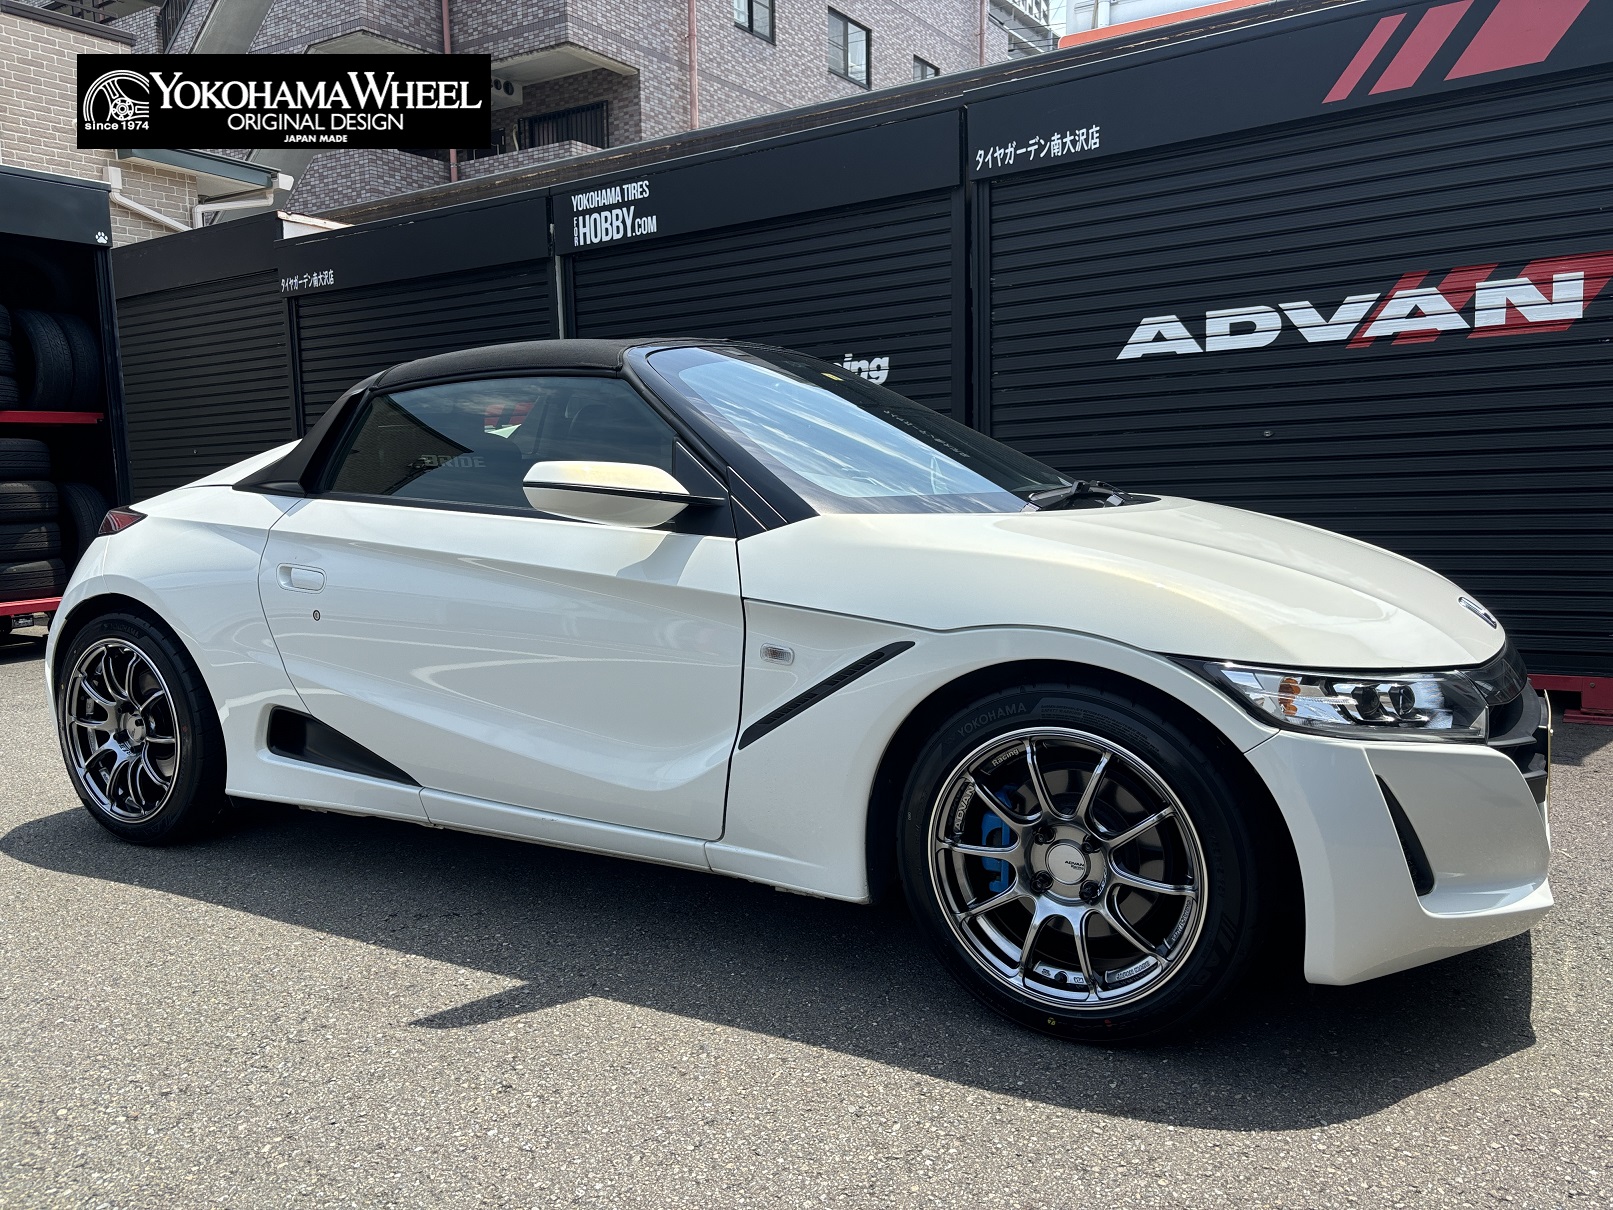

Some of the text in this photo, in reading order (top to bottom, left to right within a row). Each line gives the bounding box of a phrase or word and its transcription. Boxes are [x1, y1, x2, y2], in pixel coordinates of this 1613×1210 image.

[974, 124, 1101, 172] タイヤガーデン南大沢店
[571, 180, 650, 212] YOKOHAMA TIRES
[280, 268, 335, 293] タイヤガーデン南大沢店
[1115, 271, 1585, 360] ADVAN
[957, 701, 1028, 738] YOKOHAMA
[991, 748, 1020, 768] Racing
[954, 784, 976, 831] ADVAN
